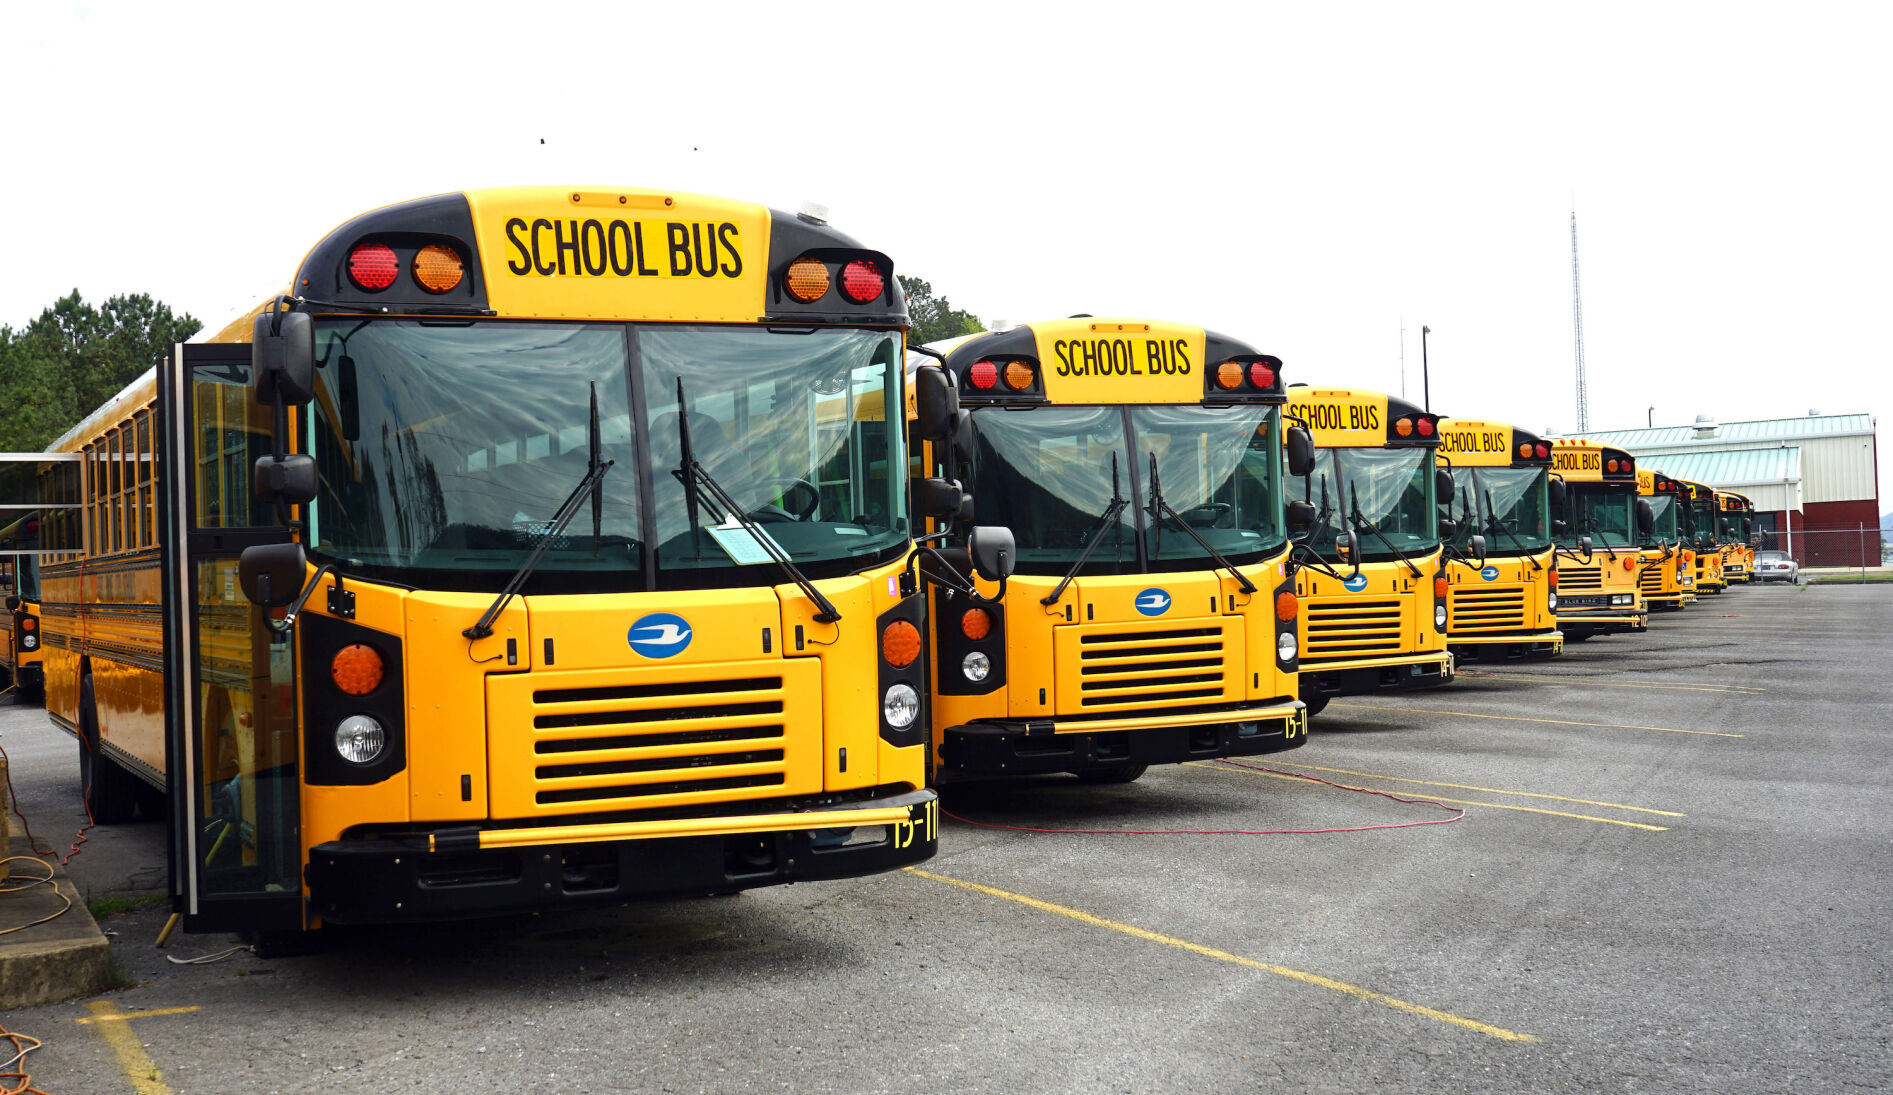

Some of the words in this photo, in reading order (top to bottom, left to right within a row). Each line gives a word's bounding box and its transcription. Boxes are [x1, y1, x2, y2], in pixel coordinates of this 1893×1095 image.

[505, 217, 659, 277] SCHOOL
[666, 222, 743, 279] BUS
[1054, 338, 1143, 377] SCHOOL
[1146, 338, 1191, 376] BUS
[1289, 403, 1347, 430] SCHOOL
[1349, 404, 1379, 430] BUS
[1438, 432, 1481, 453] SCHOOL
[1482, 432, 1505, 453] BUS
[1549, 453, 1581, 471] CHOOL
[1582, 453, 1600, 471] BUS
